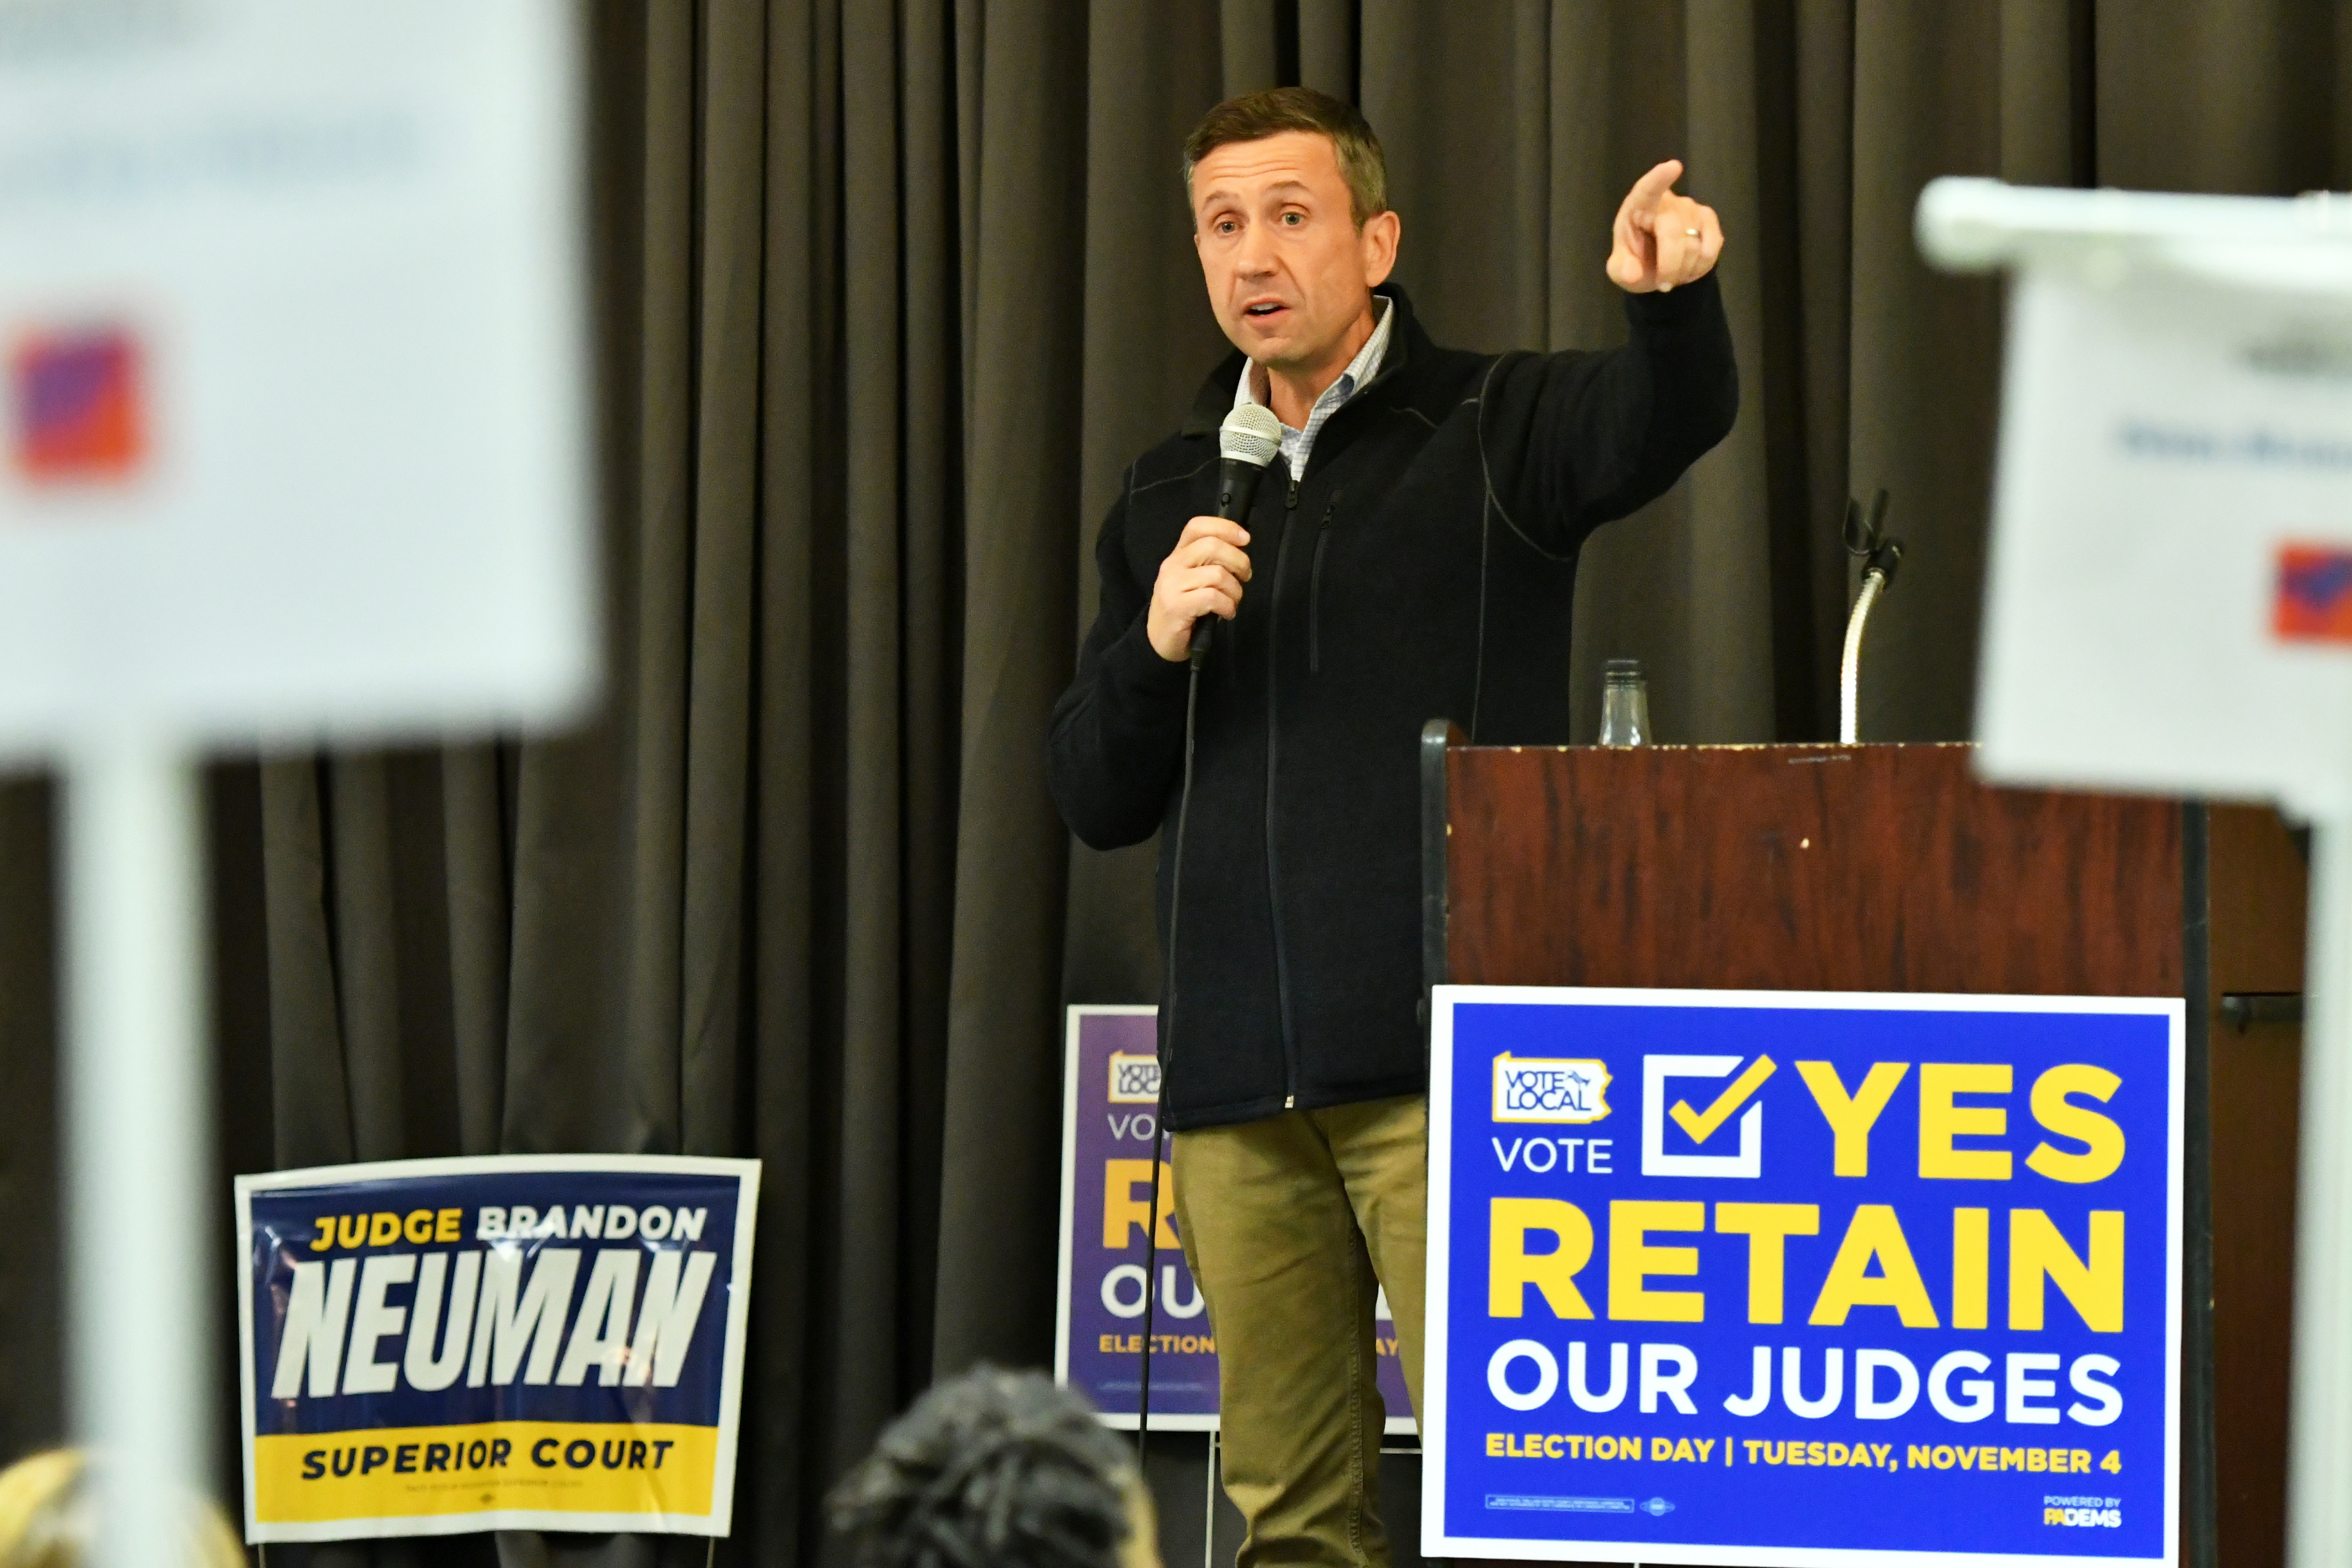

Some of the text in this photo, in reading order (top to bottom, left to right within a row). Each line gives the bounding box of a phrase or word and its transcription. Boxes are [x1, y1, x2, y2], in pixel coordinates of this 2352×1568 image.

[1119, 1077, 1160, 1093] LOC
[1505, 1070, 1564, 1089] VOTE
[1507, 1089, 1591, 1111] LOCAL
[1794, 1060, 2126, 1184] YES
[1492, 1137, 1613, 1174] VOTE
[310, 1204, 707, 1251] JUDGE BRANDON
[1488, 1197, 2125, 1333] RETAIN
[1101, 1264, 1205, 1319] OU
[271, 1248, 717, 1399] NEUMAN
[1487, 1339, 2123, 1427] OUR JUDGES
[302, 1438, 674, 1480] SUPERIOR COURT
[1486, 1433, 1642, 1461] ELECTION
[1651, 1437, 1715, 1462] DAY
[1743, 1440, 1898, 1473] TUESDAY,
[1907, 1444, 2091, 1474] NOVEMBER
[2100, 1450, 2122, 1475] 4
[2044, 1496, 2121, 1507] POWERED BY
